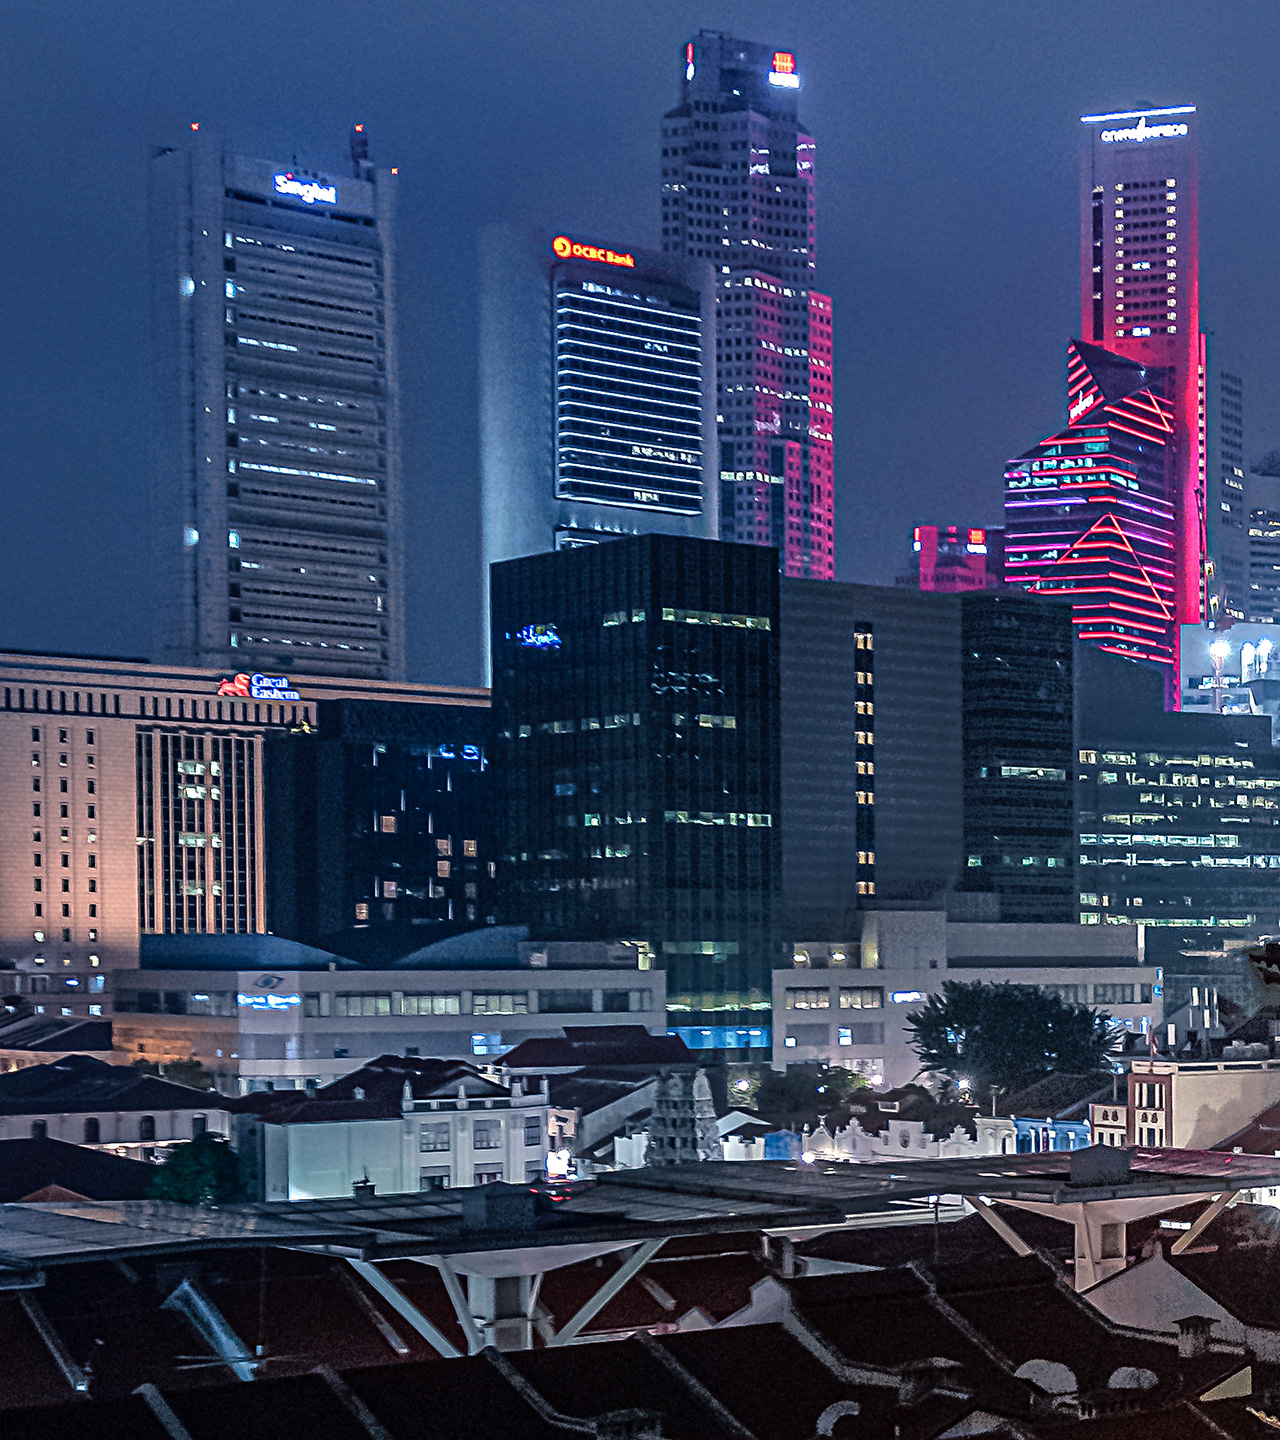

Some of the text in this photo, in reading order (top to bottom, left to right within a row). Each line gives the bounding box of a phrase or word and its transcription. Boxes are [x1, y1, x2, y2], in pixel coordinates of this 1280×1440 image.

[572, 243, 635, 268] OCBC Bank
[251, 673, 288, 688] Great
[251, 686, 301, 700] Eastern
